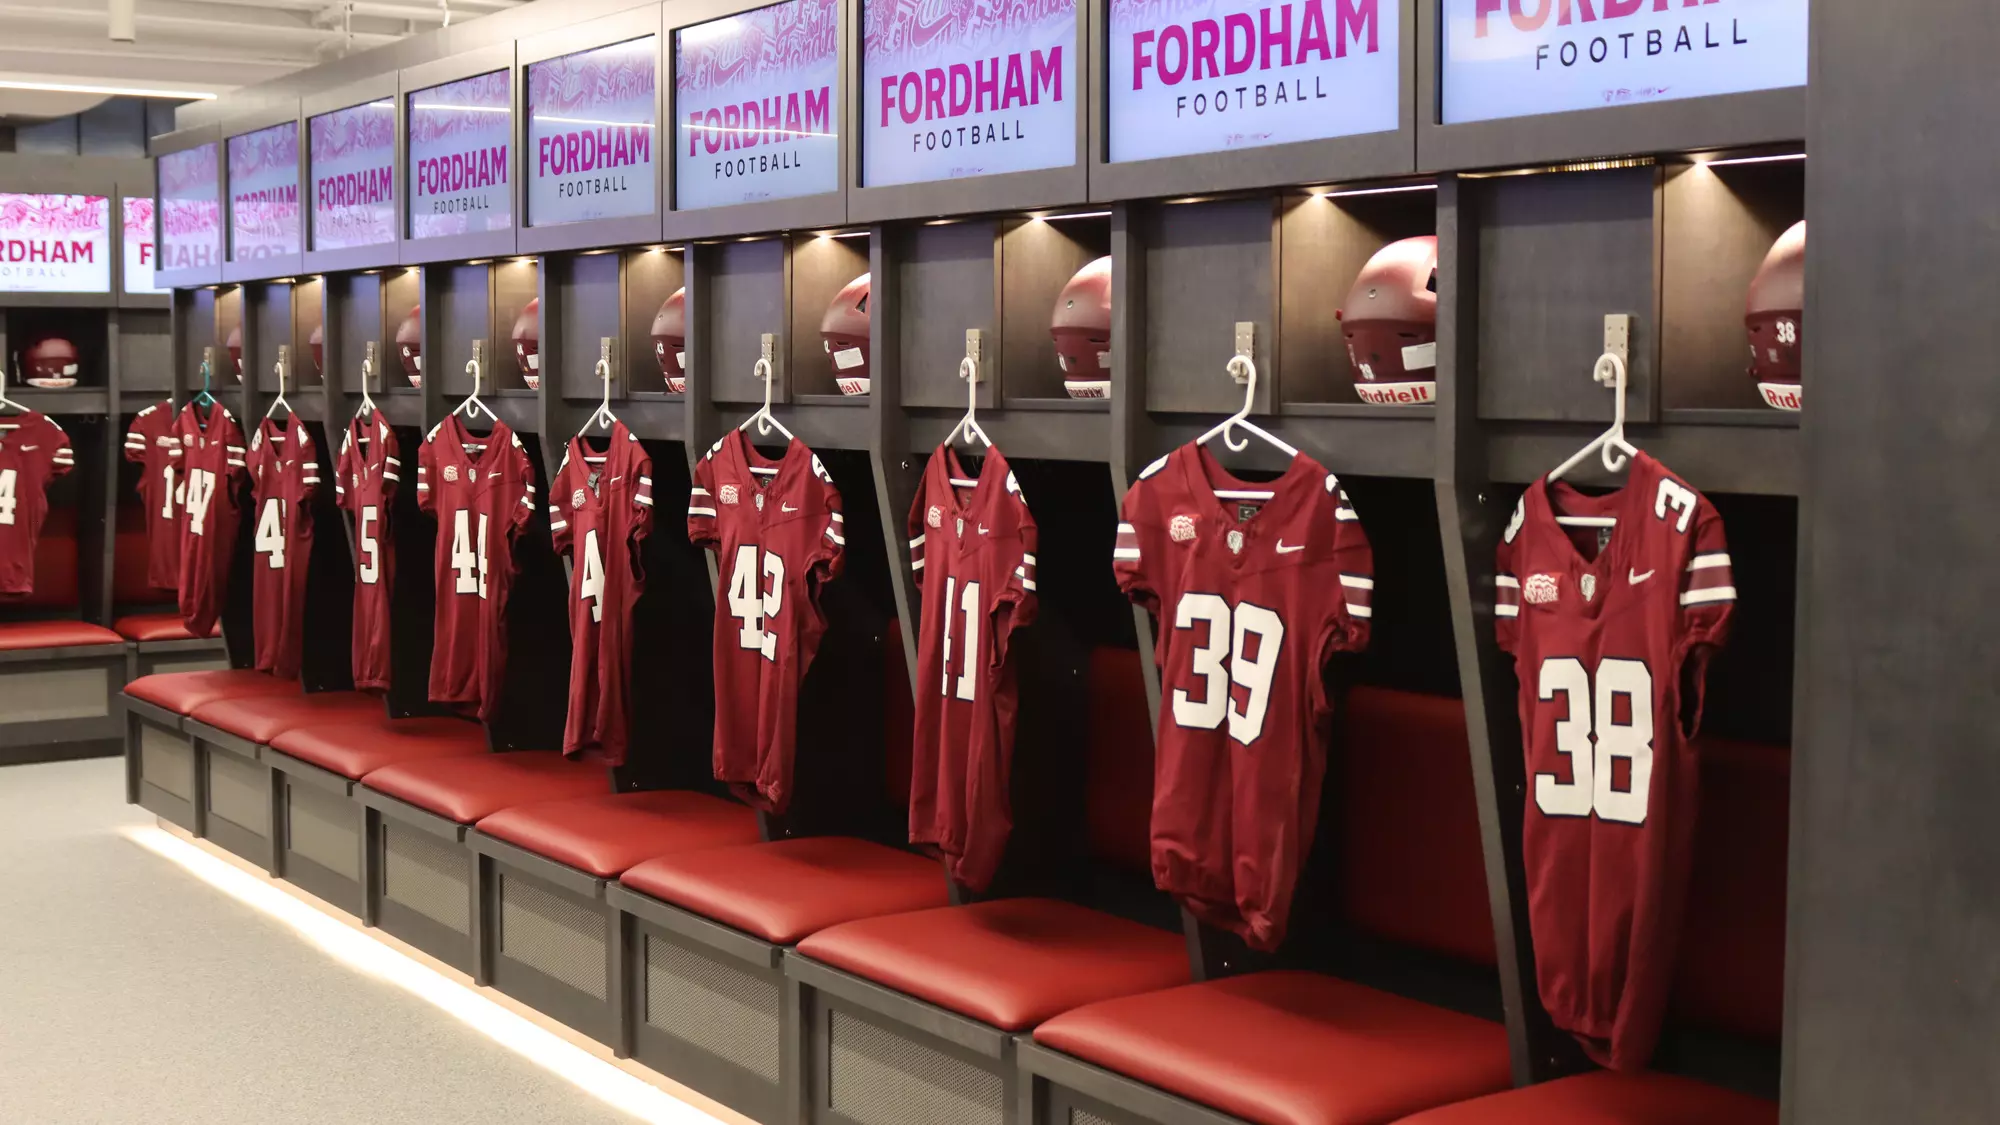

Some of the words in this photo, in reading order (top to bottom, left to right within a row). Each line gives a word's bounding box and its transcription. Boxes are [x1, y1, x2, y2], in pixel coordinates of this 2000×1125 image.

[1133, 0, 1379, 90] FORDHAM
[1536, 18, 1748, 70] FOOTBALL
[881, 46, 1063, 127] FORDHAM
[1177, 76, 1327, 117] FOOTBALL
[689, 86, 830, 157] FORDHAM
[913, 119, 1025, 152] FOOTBALL
[417, 145, 508, 196] FORDHAM
[538, 121, 650, 178] FORDHAM
[715, 150, 801, 180] FOOTBALL
[318, 166, 393, 211] FORDHAM
[434, 195, 489, 214] FOOTBALL
[558, 175, 627, 199] FOOTBALL
[0, 239, 94, 263] DHAM
[1775, 321, 1796, 343] 38
[1359, 386, 1428, 402] Riddell
[1765, 388, 1801, 408] Rid
[186, 468, 216, 536] 47
[255, 498, 286, 569] 4
[360, 505, 379, 584] 5
[728, 545, 785, 662] 42
[1172, 592, 1285, 747] 39
[1535, 657, 1654, 827] 38
